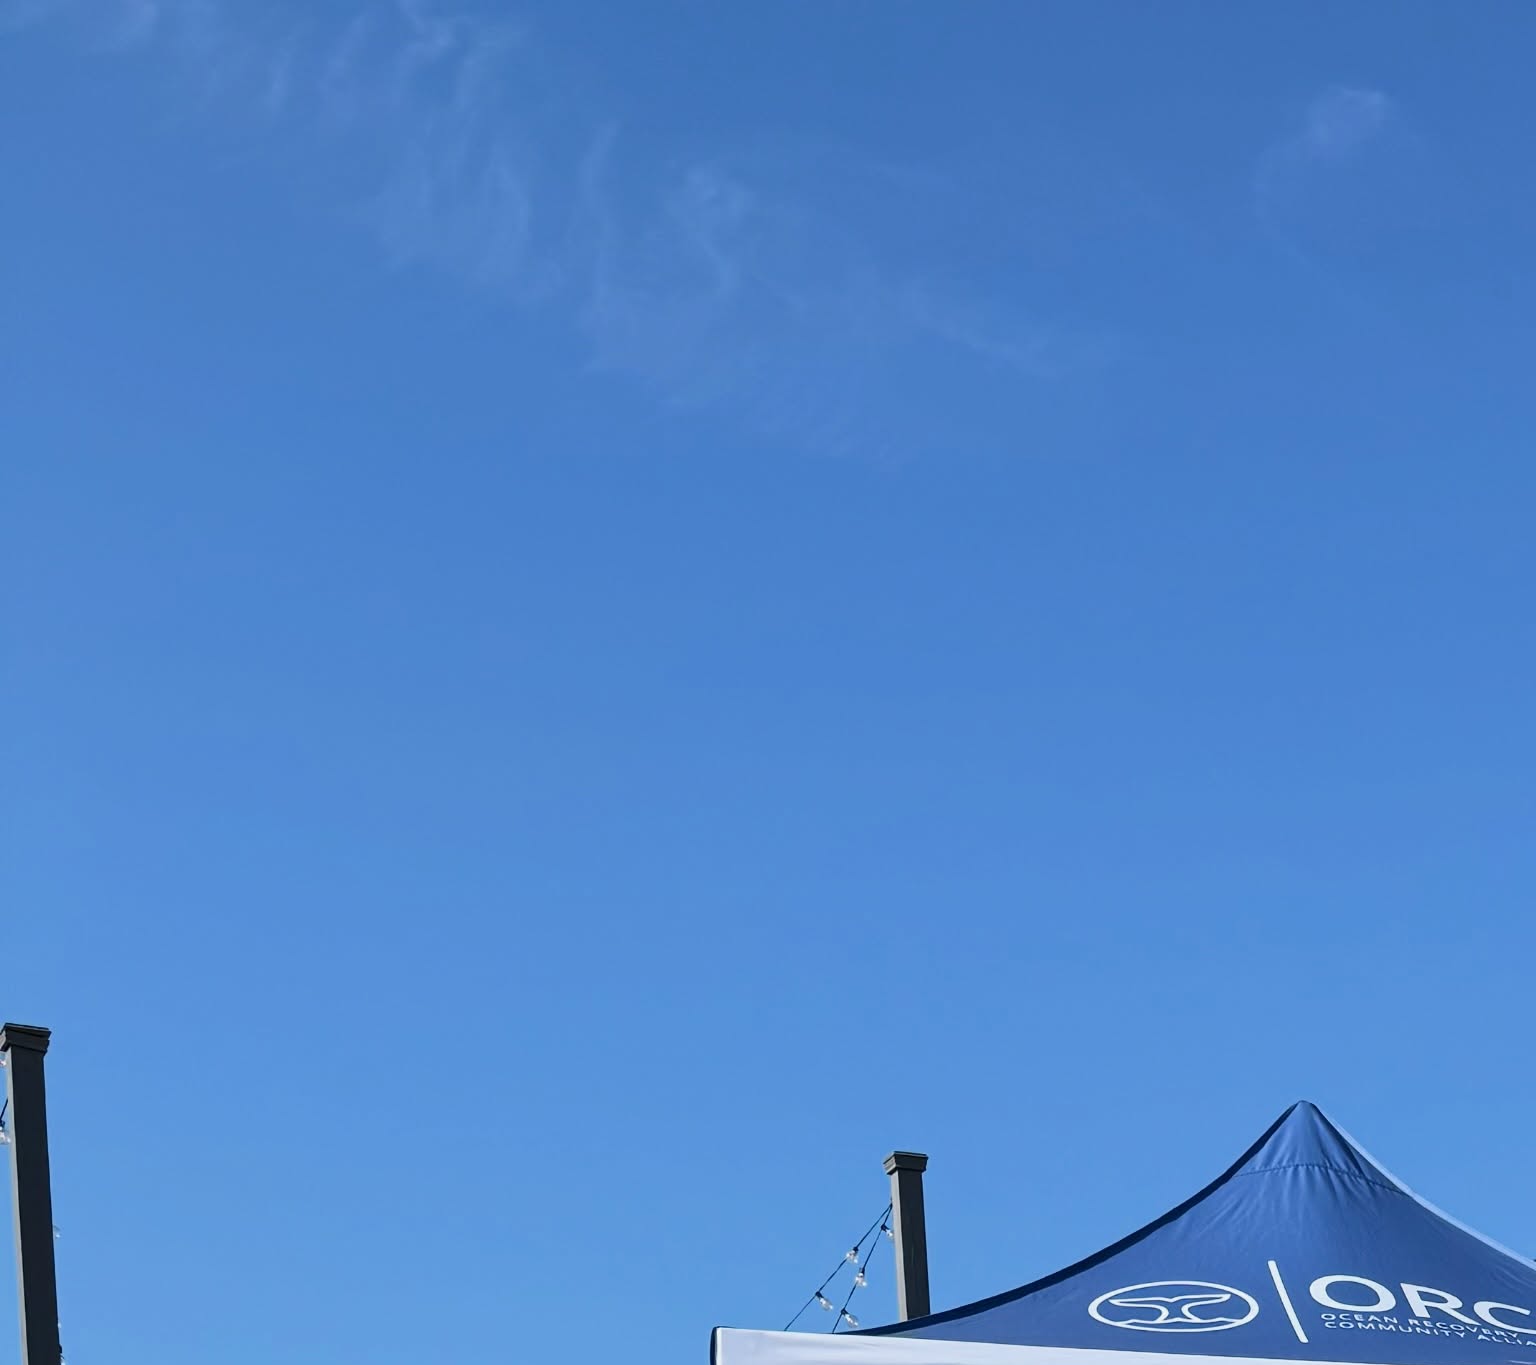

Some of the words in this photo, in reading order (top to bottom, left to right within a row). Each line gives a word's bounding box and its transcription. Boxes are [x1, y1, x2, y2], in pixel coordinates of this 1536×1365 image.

[1321, 1313, 1398, 1325] OCEAN
[1408, 1318, 1518, 1338] RECOVERY
[1324, 1321, 1466, 1339] COMMUNITY
